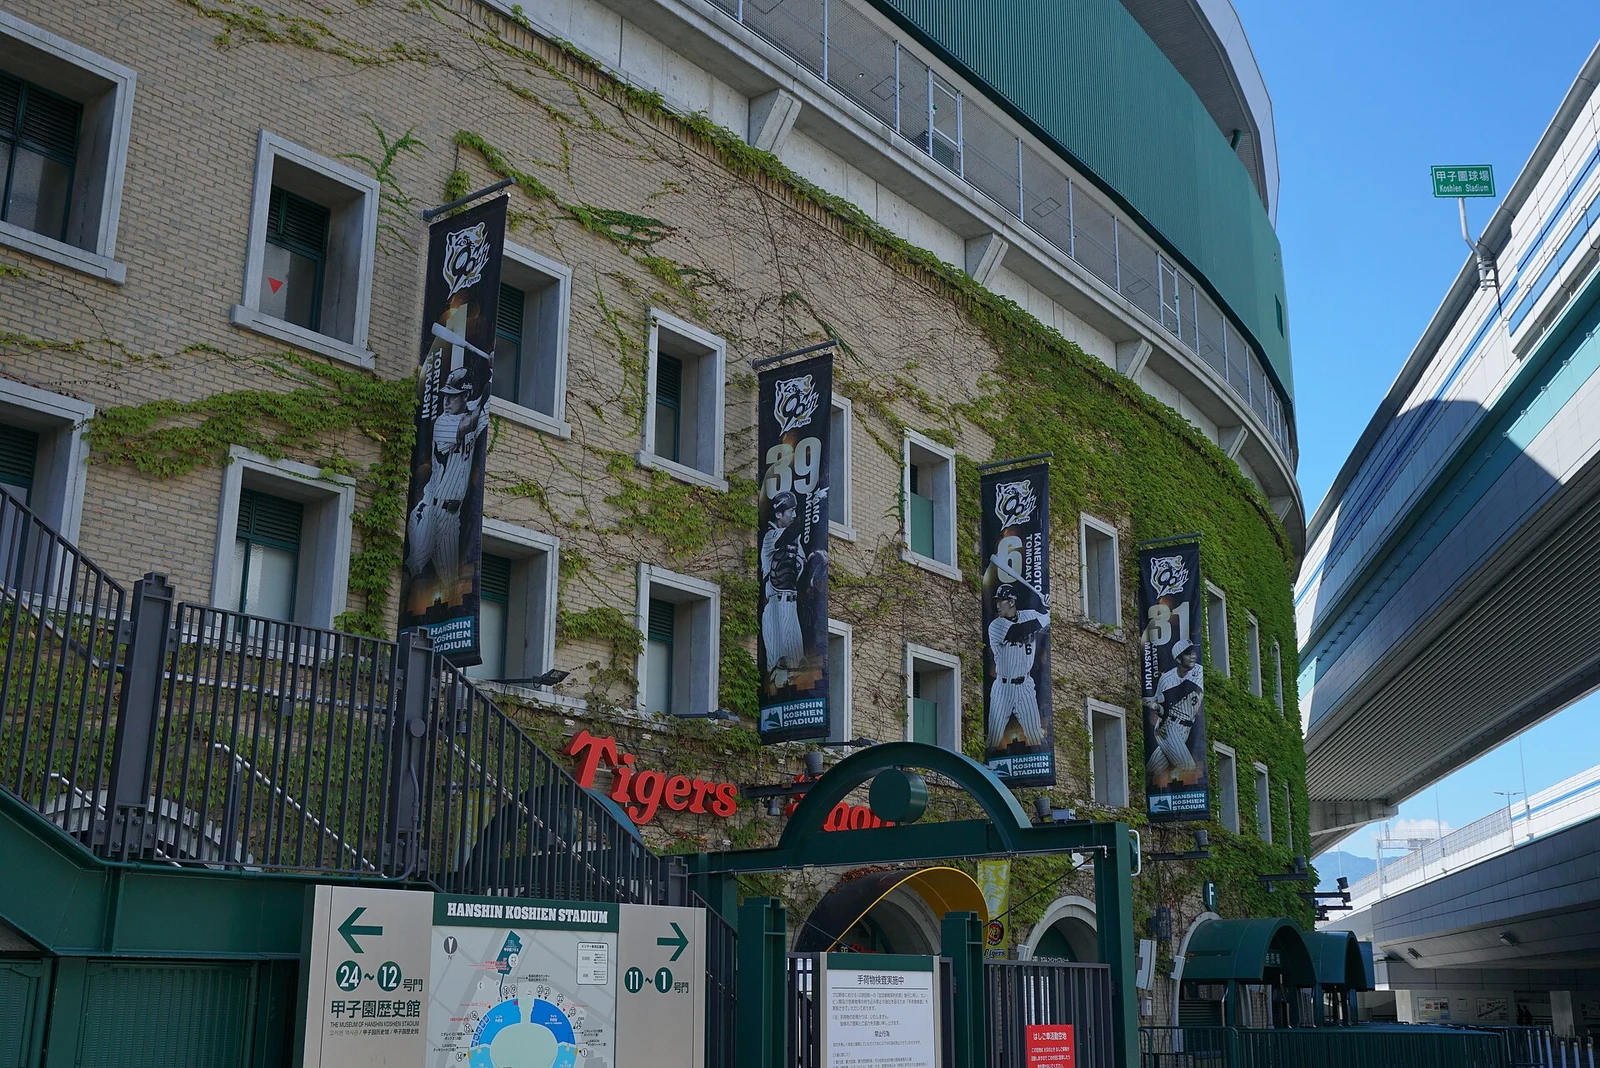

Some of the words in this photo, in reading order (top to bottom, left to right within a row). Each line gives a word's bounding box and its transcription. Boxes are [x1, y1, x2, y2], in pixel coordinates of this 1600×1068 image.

[1436, 170, 1489, 182] 甲子園球場
[1439, 183, 1462, 193] Koshien
[1465, 183, 1489, 192] Stadium
[421, 351, 434, 419] TAKASHI
[431, 347, 443, 421] TORITANI
[765, 437, 822, 500] 39
[803, 492, 813, 544] AKIHIRO
[997, 535, 1023, 584] 6
[1024, 534, 1033, 583] TOMOAKI
[1034, 532, 1043, 591] KANEMOTO
[430, 620, 471, 635] HANSHIN
[1148, 601, 1190, 645] 31
[434, 639, 472, 653] TADIUM
[1143, 641, 1153, 690] MASAYUKI
[1151, 641, 1159, 678] KAKEFU
[783, 701, 823, 712] HANSHIN
[783, 709, 824, 720] KOSHIEN
[783, 716, 824, 727] STADIUM
[1012, 755, 1049, 764] HANSHIN
[1012, 762, 1049, 770] KOSHIEN
[565, 730, 738, 825] Tigers
[1012, 768, 1050, 777] STADIUM
[1208, 882, 1215, 906] F
[447, 902, 503, 919] HANSHIN
[505, 905, 557, 922] KOSHIEN
[558, 908, 608, 924] STADIUM
[340, 965, 360, 988] 24
[382, 966, 398, 988] 12
[402, 978, 424, 992] 号門
[628, 971, 639, 990] 11
[661, 971, 667, 990] 1
[674, 982, 690, 994] 号門
[857, 974, 905, 986] 手荷物検査実施中
[331, 1000, 420, 1018] 甲子園歴史館
